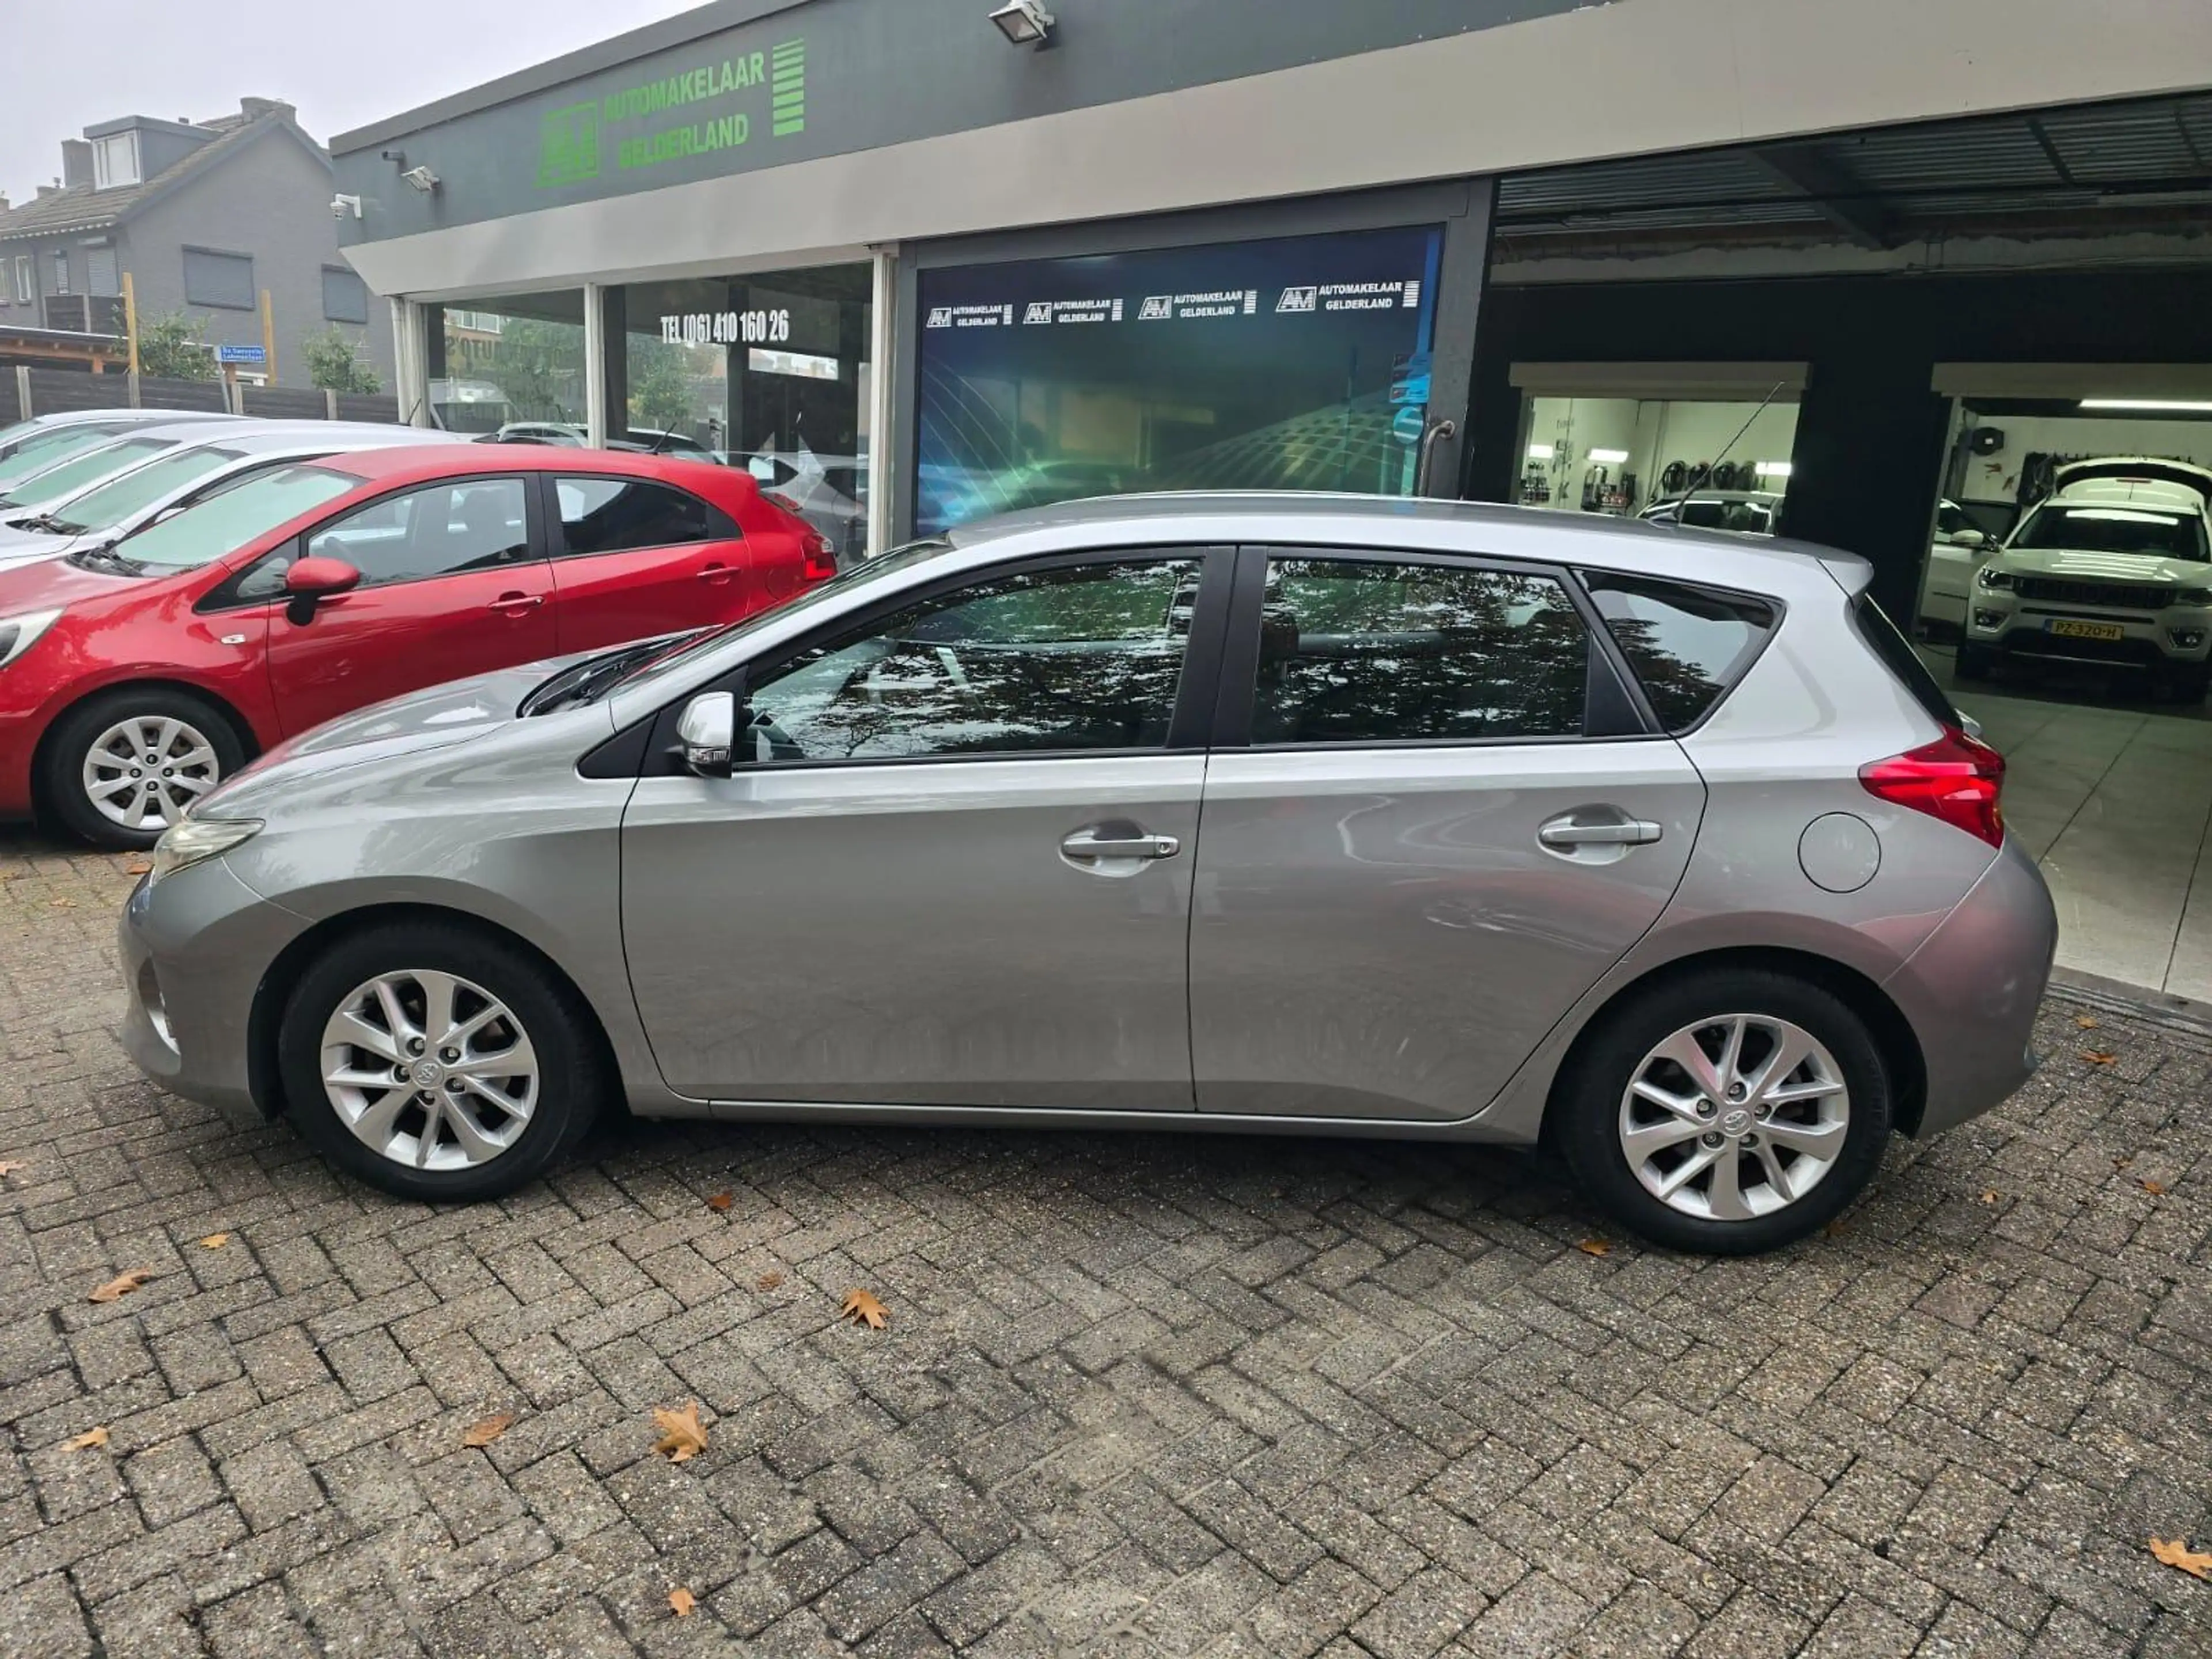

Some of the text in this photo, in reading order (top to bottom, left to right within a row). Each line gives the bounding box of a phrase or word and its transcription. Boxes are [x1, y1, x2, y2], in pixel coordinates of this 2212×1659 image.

[605, 51, 766, 122] AUTOMAKELAAR
[619, 114, 749, 168] GELDERLAND
[1319, 281, 1402, 296] AUTOMAKELAAR
[1174, 290, 1243, 304] AUTOMAKELAAR
[1325, 298, 1393, 311] GELDERLAND
[1180, 306, 1236, 318] GELDERLAND
[661, 309, 790, 344] TEL (06) 410 160 26
